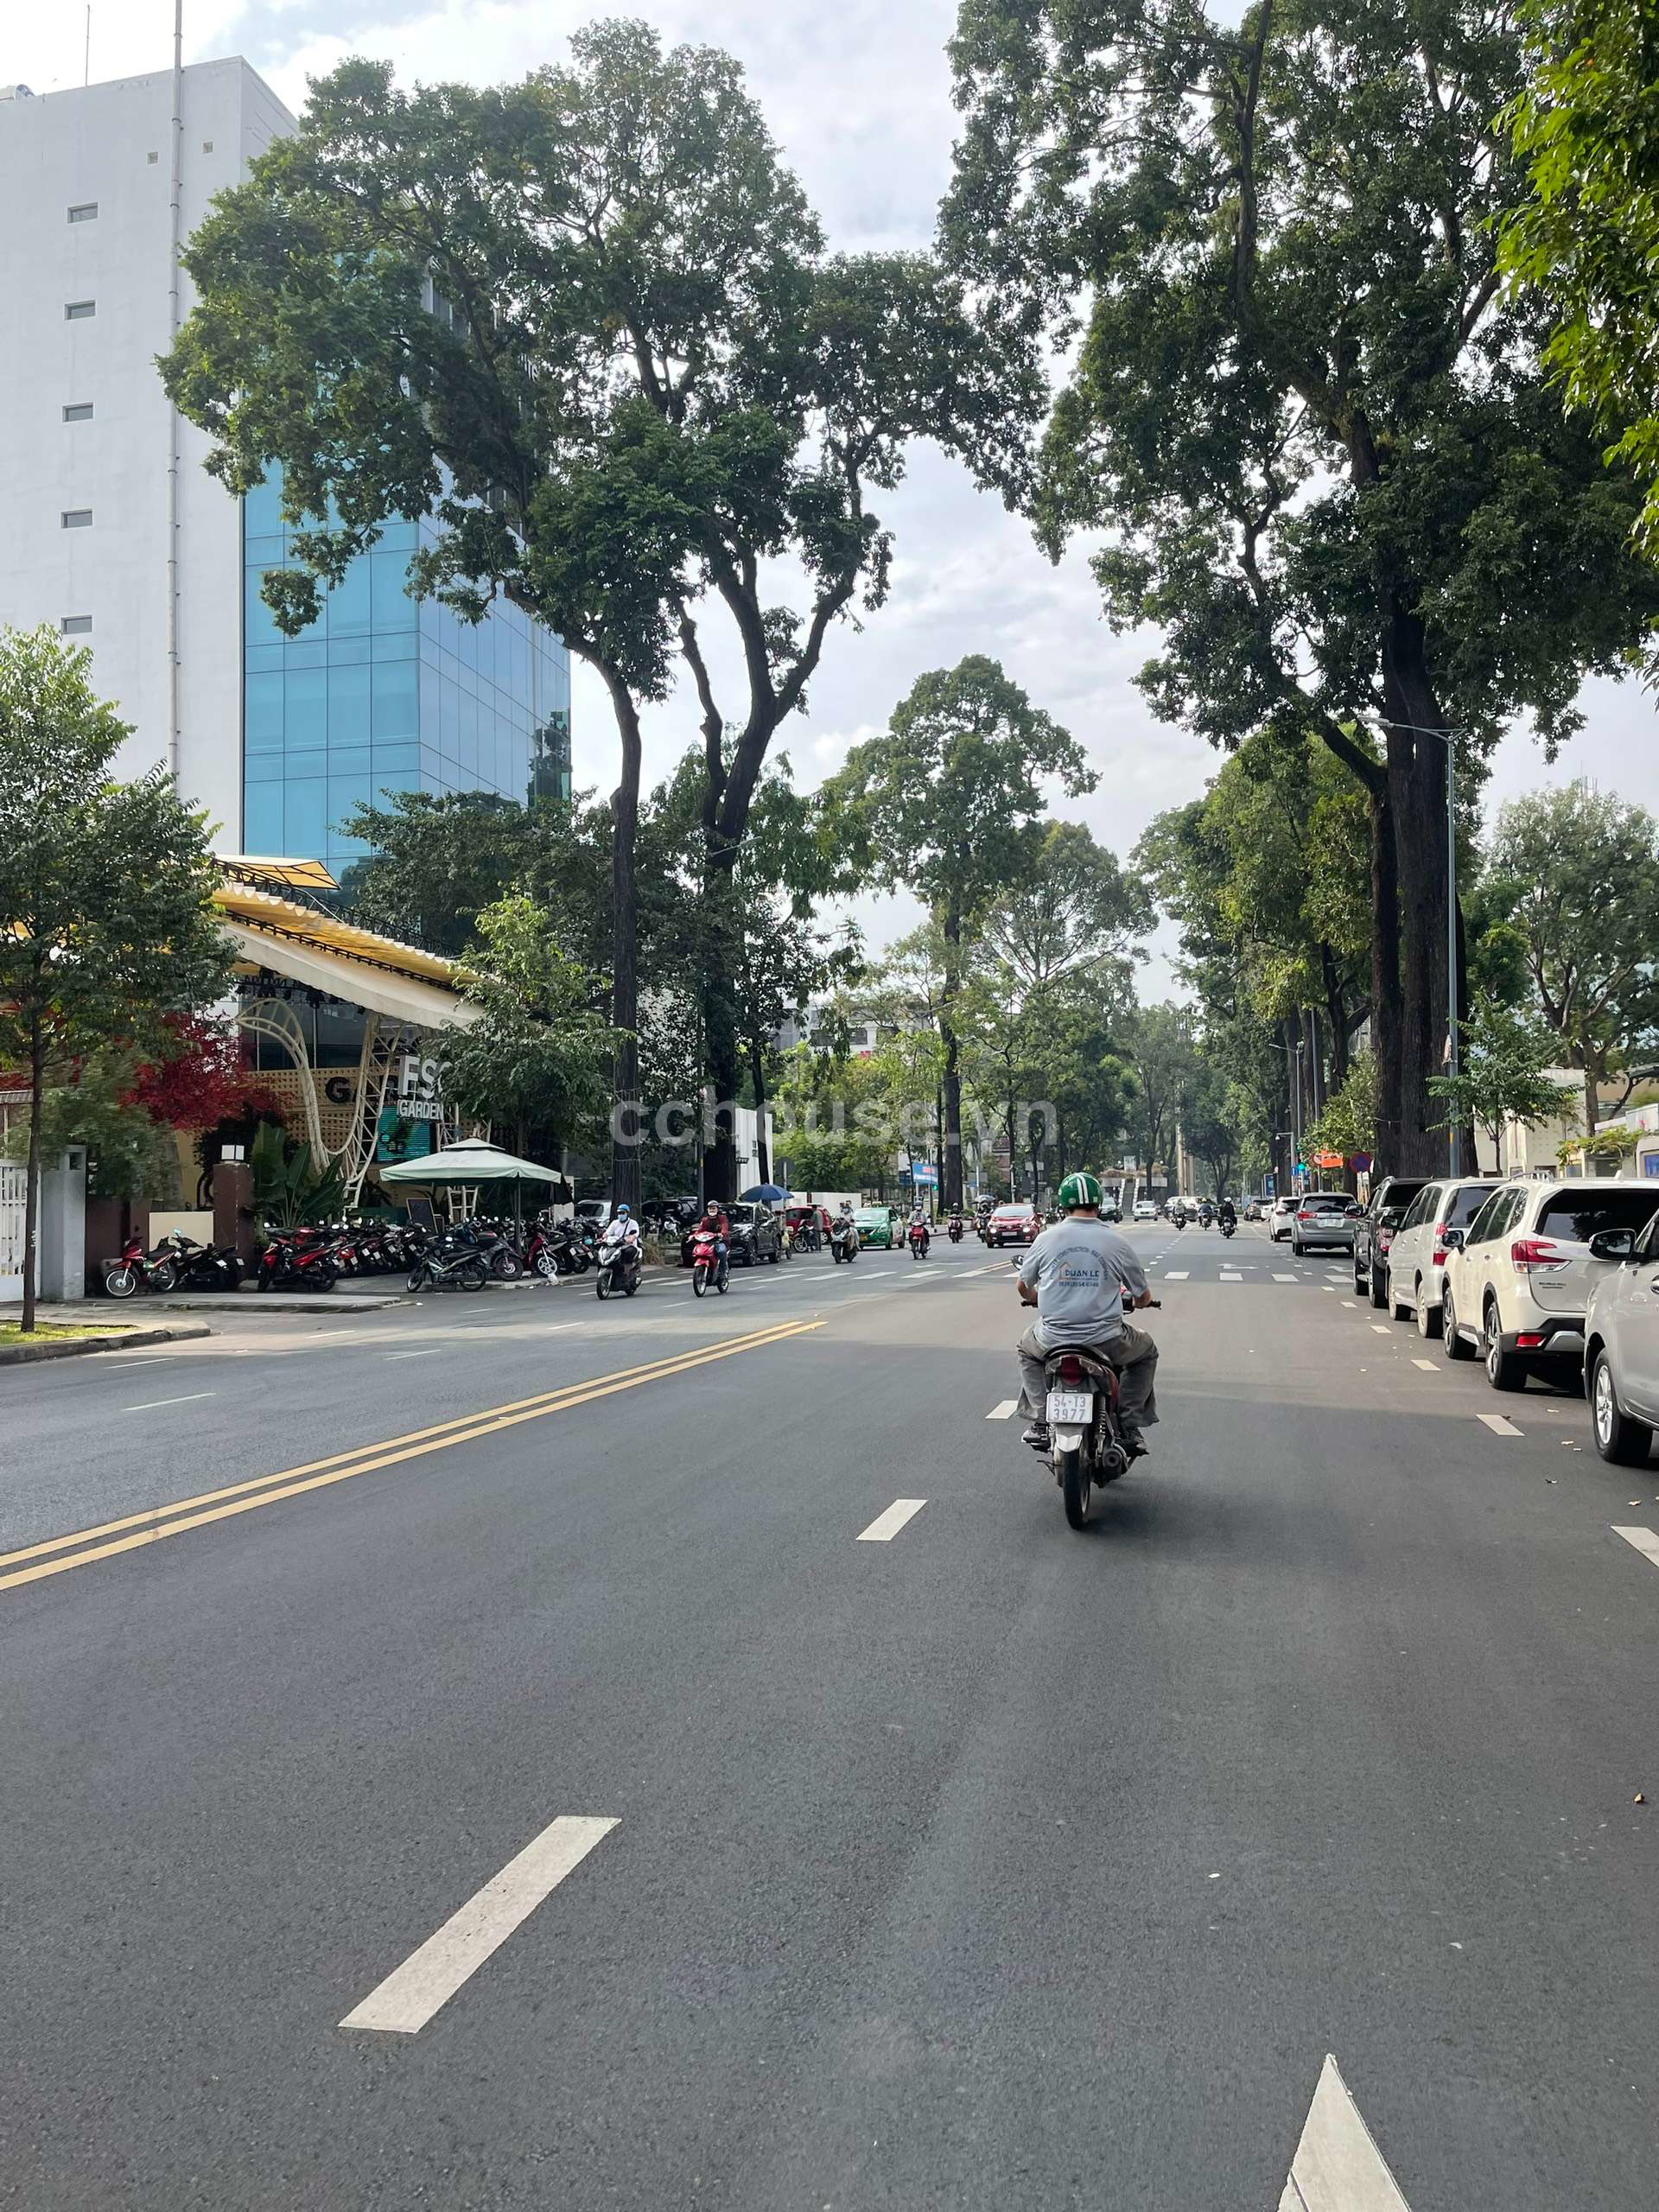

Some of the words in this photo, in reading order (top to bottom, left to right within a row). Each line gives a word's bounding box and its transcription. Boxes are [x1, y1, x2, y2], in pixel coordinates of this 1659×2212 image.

[397, 1100, 443, 1121] GARDEN
[1054, 1395, 1085, 1408] 54-T3
[1053, 1408, 1085, 1421] 3977
